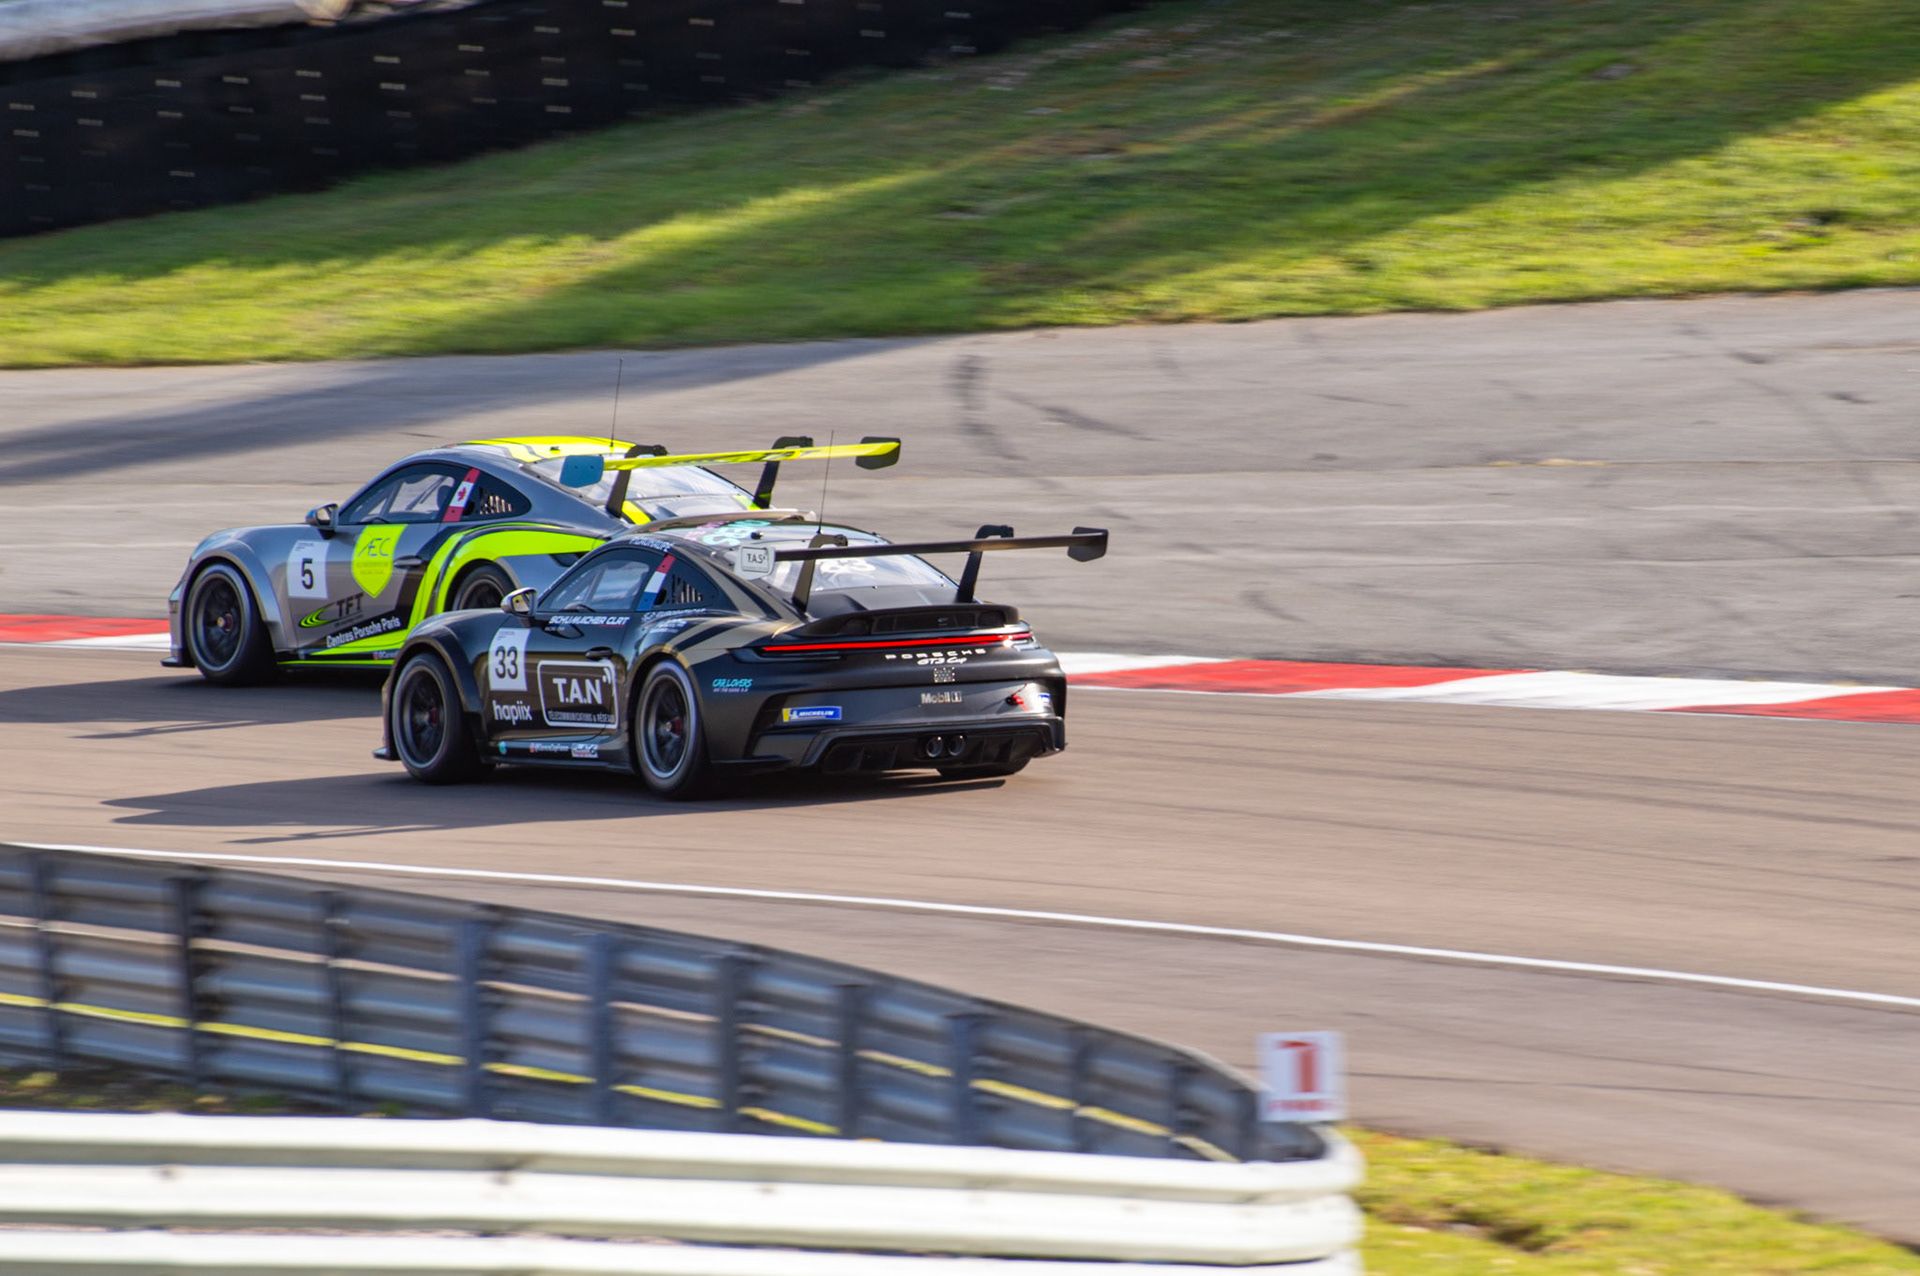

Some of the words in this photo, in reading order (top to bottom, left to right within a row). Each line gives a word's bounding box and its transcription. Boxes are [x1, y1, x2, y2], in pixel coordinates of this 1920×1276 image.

[301, 557, 315, 590] 5
[336, 592, 364, 617] TFT
[326, 630, 354, 648] Centres
[352, 620, 382, 638] Porsche
[380, 615, 402, 632] Paris
[549, 615, 606, 625] SCHUMACHER
[495, 646, 518, 679] 33
[885, 648, 987, 660] PORSCHE
[917, 657, 942, 666] GT3
[947, 656, 968, 665] Cup
[921, 692, 951, 704] Mobil
[492, 699, 533, 725] hapiix
